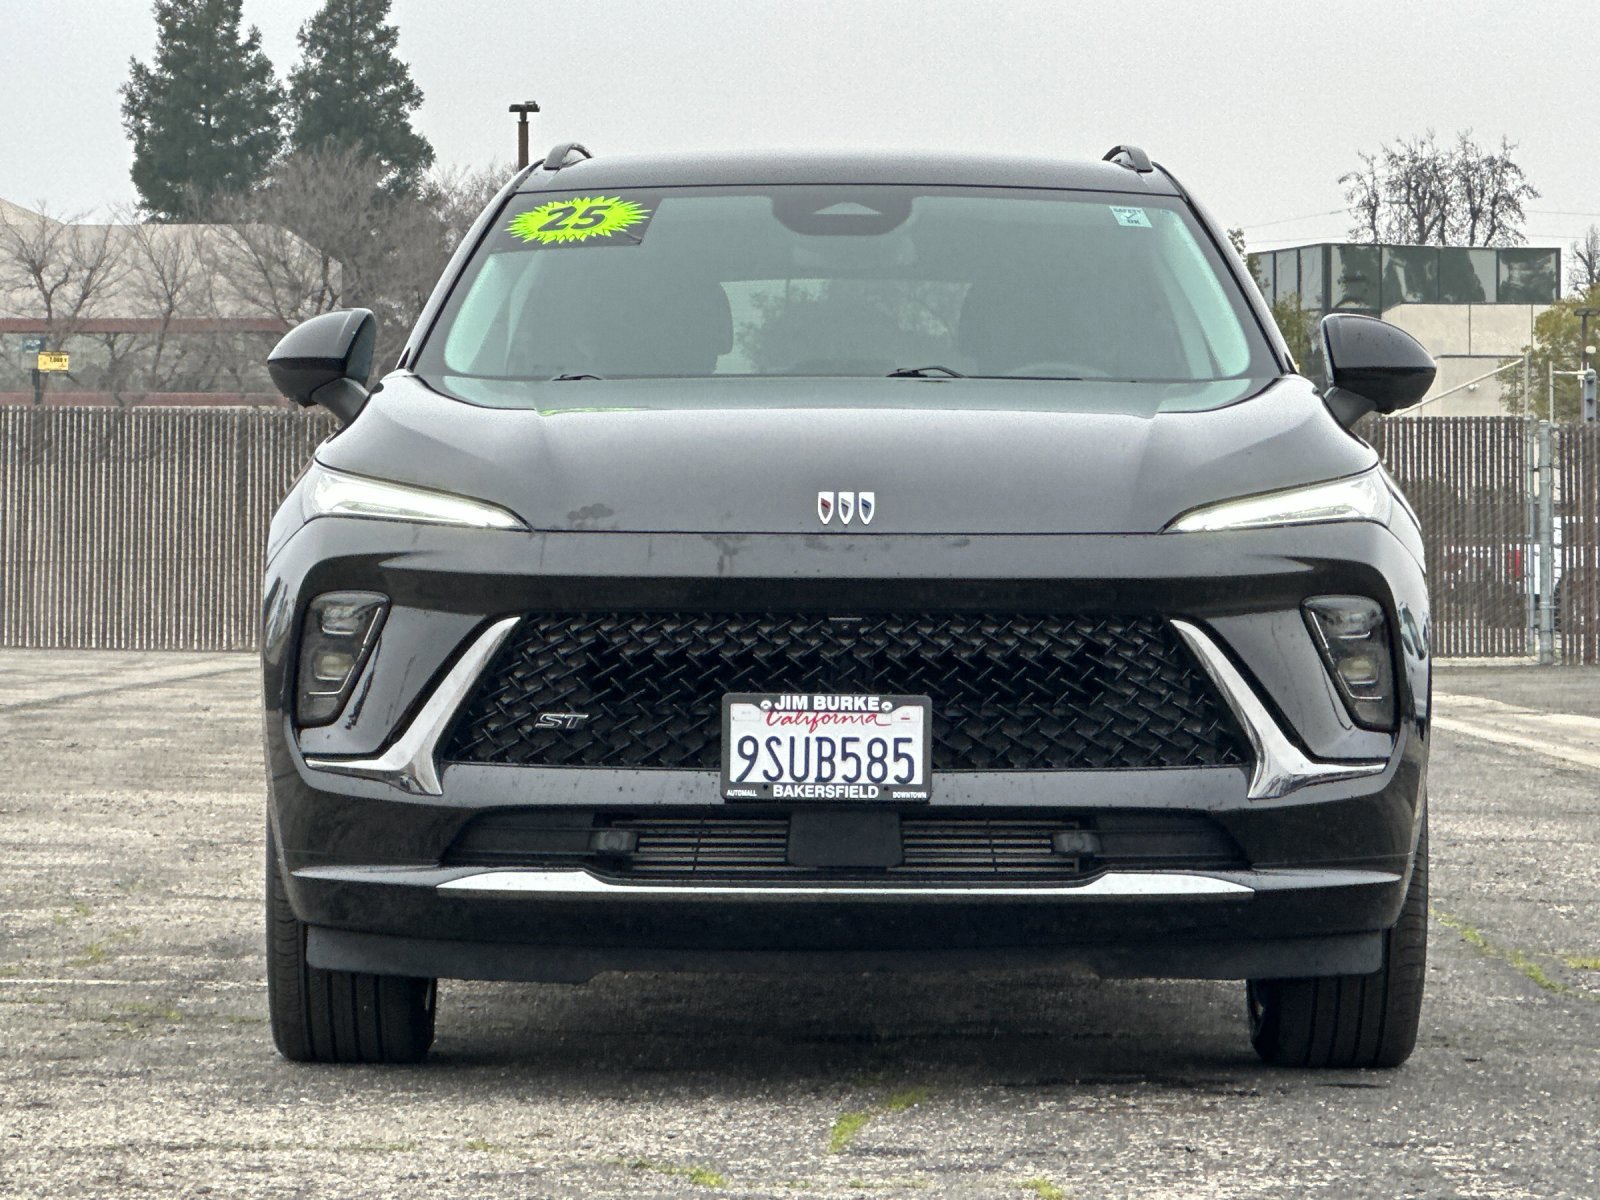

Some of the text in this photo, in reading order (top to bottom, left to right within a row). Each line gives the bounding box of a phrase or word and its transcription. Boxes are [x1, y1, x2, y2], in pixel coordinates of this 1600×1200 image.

[538, 205, 613, 232] 25
[775, 695, 880, 711] JIM BURKE
[534, 713, 589, 729] ST
[766, 709, 892, 734] California
[735, 735, 915, 784] 9SUB585
[726, 789, 757, 797] AUTOMALL
[772, 785, 879, 799] BAKERSFIELD
[892, 791, 927, 799] DOWNTOWN
